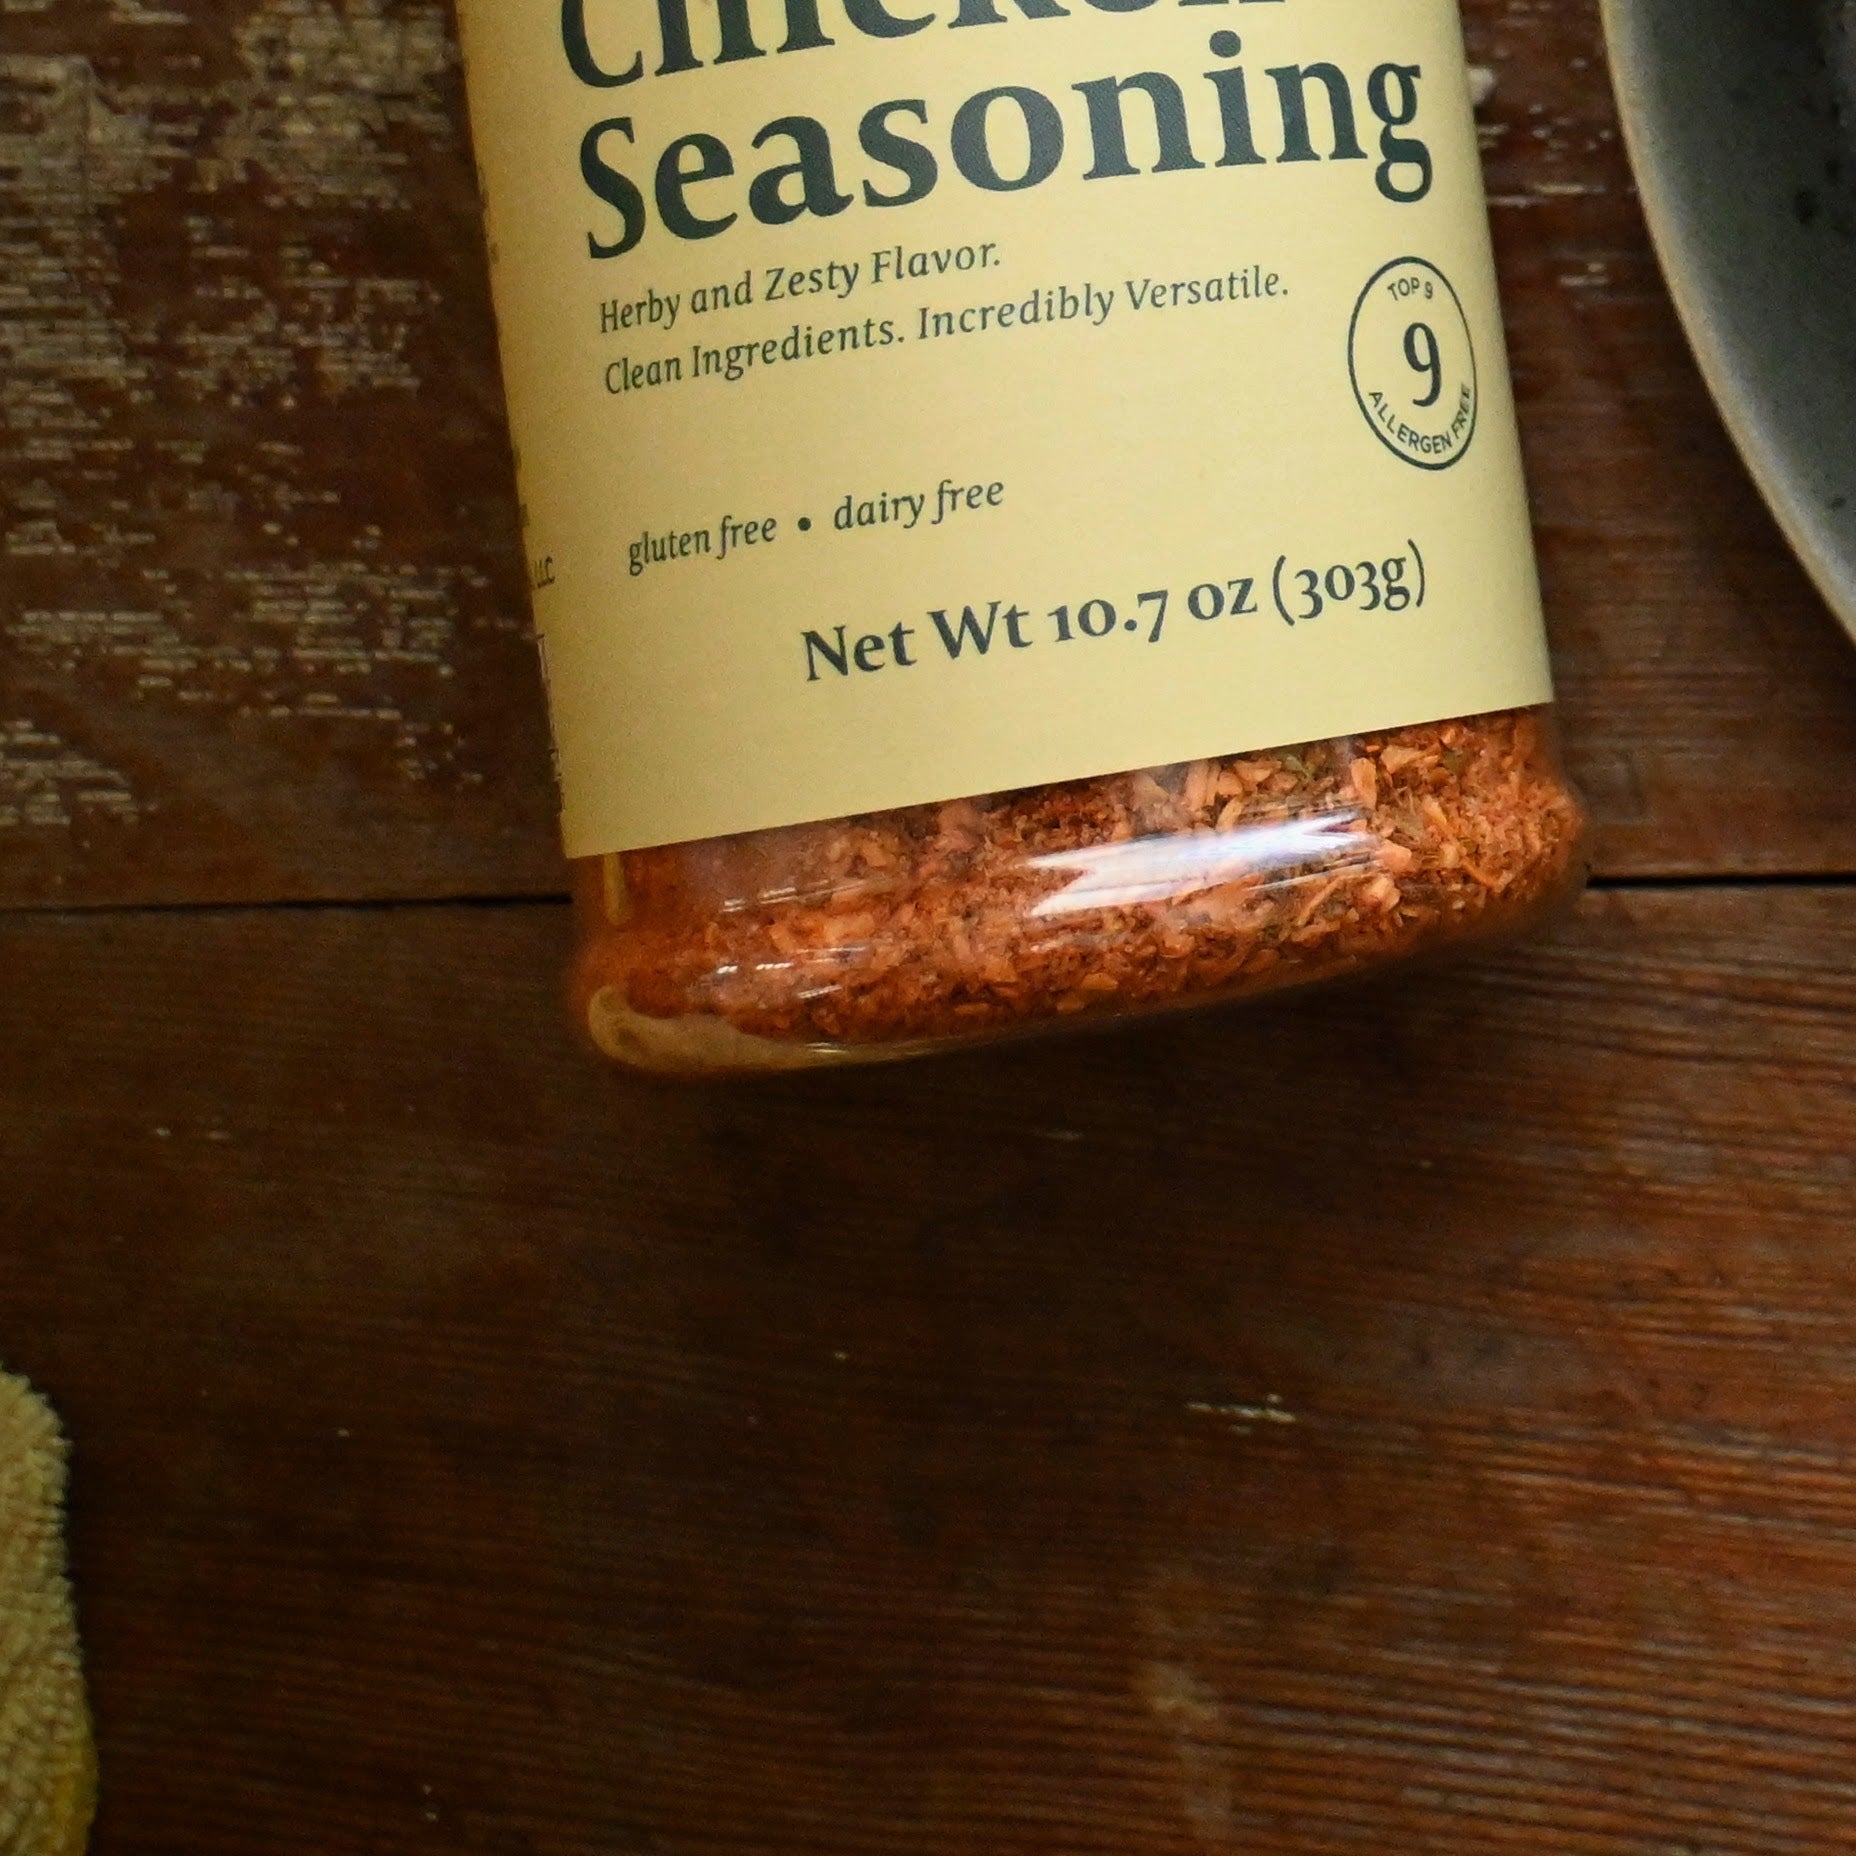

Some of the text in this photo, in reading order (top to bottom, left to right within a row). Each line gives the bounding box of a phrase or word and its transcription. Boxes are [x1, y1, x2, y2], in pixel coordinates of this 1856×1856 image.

[578, 29, 1434, 261] Seasoning
[599, 242, 1002, 335] Herby and Zesty Flavor.
[604, 264, 1289, 395] Clean Ingredients. Incredibly Versatile.
[1386, 276, 1434, 302] TOP 9
[1402, 321, 1443, 408] 9
[1368, 381, 1471, 455] ALLERGEN FREE
[627, 478, 1005, 578] gluten free dairy free
[799, 538, 1426, 683] Net Wt 10.7 oz (303g)
